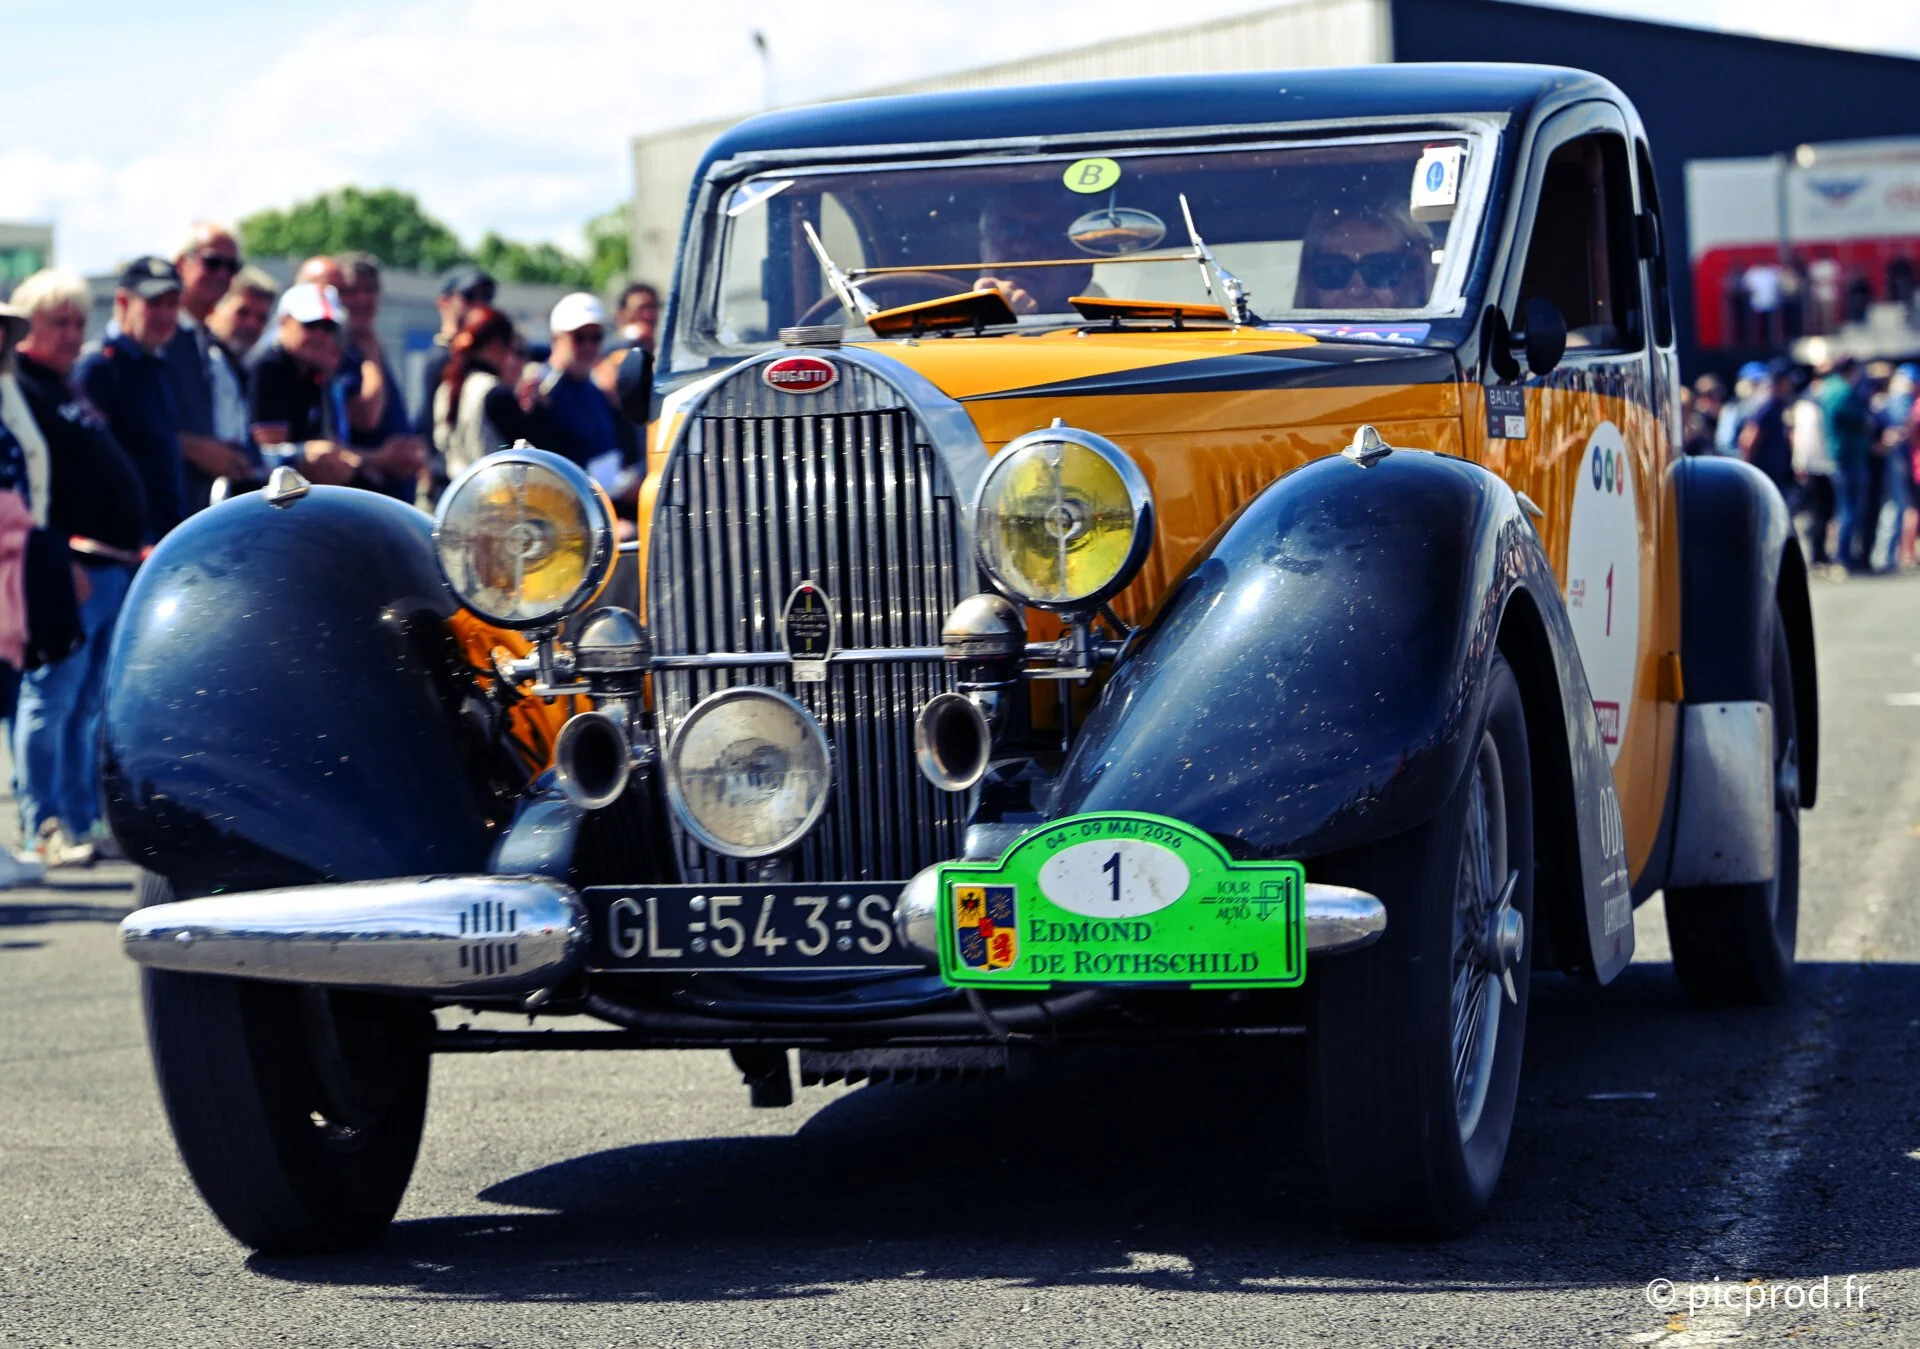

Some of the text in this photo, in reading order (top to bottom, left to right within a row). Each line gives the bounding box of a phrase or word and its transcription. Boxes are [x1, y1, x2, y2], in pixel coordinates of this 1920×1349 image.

[1078, 164, 1103, 187] B
[1489, 389, 1521, 406] BALTIC
[1606, 561, 1614, 637] 1
[1045, 832, 1067, 850] 04
[1080, 822, 1103, 836] 09
[1107, 821, 1139, 834] MAI
[1142, 825, 1183, 849] 2026
[1102, 852, 1121, 902] 1
[608, 894, 893, 958] GL-543-S
[1028, 919, 1152, 942] EDMOND
[1029, 950, 1260, 974] DE ROTHSCHILD
